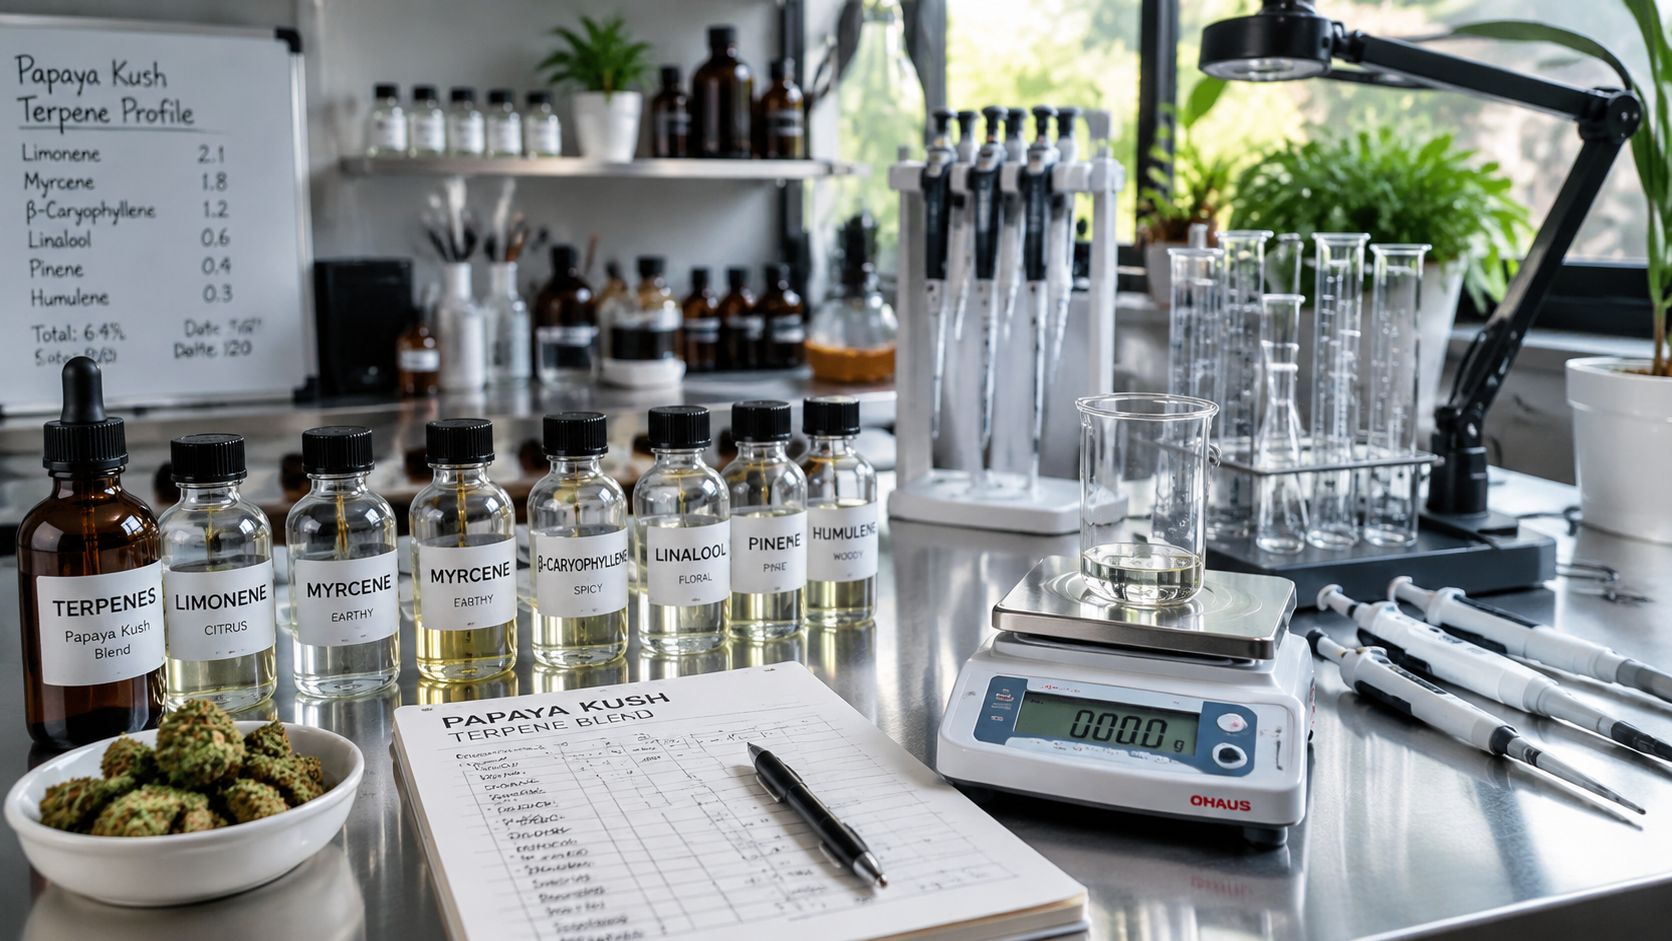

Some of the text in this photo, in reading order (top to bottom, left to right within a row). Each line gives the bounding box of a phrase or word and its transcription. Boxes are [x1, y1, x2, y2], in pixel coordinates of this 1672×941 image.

[14, 54, 168, 97] Papaya Kush
[17, 96, 195, 134] Terpene Profile
[22, 143, 225, 163] Limonene 2.1
[24, 172, 228, 198] Myrcene 1.8
[26, 200, 229, 225] β-Caryophyllene 1.2
[29, 227, 230, 249] Linalool 0.6
[29, 257, 232, 278] Pinene 0.4
[31, 284, 233, 307] Humulene 0.3
[31, 324, 77, 343] Total:
[813, 522, 876, 541] HUMULENE
[655, 543, 726, 562] LINALOOL
[430, 561, 511, 584] MYRCENE
[679, 575, 712, 585] FLORAL
[175, 584, 267, 611] LIMONENE
[306, 574, 392, 599] MYRCENE
[574, 584, 603, 595] SPICY
[53, 587, 156, 617] TERPENES
[331, 608, 374, 623] EARTHY
[65, 620, 151, 646] Papaya Kush
[204, 620, 248, 637] CITRUS
[95, 645, 131, 660] Blend
[441, 692, 671, 729] PAPAYA KUSH
[447, 719, 569, 743] TERPENE
[1190, 795, 1252, 812] OHAUS
